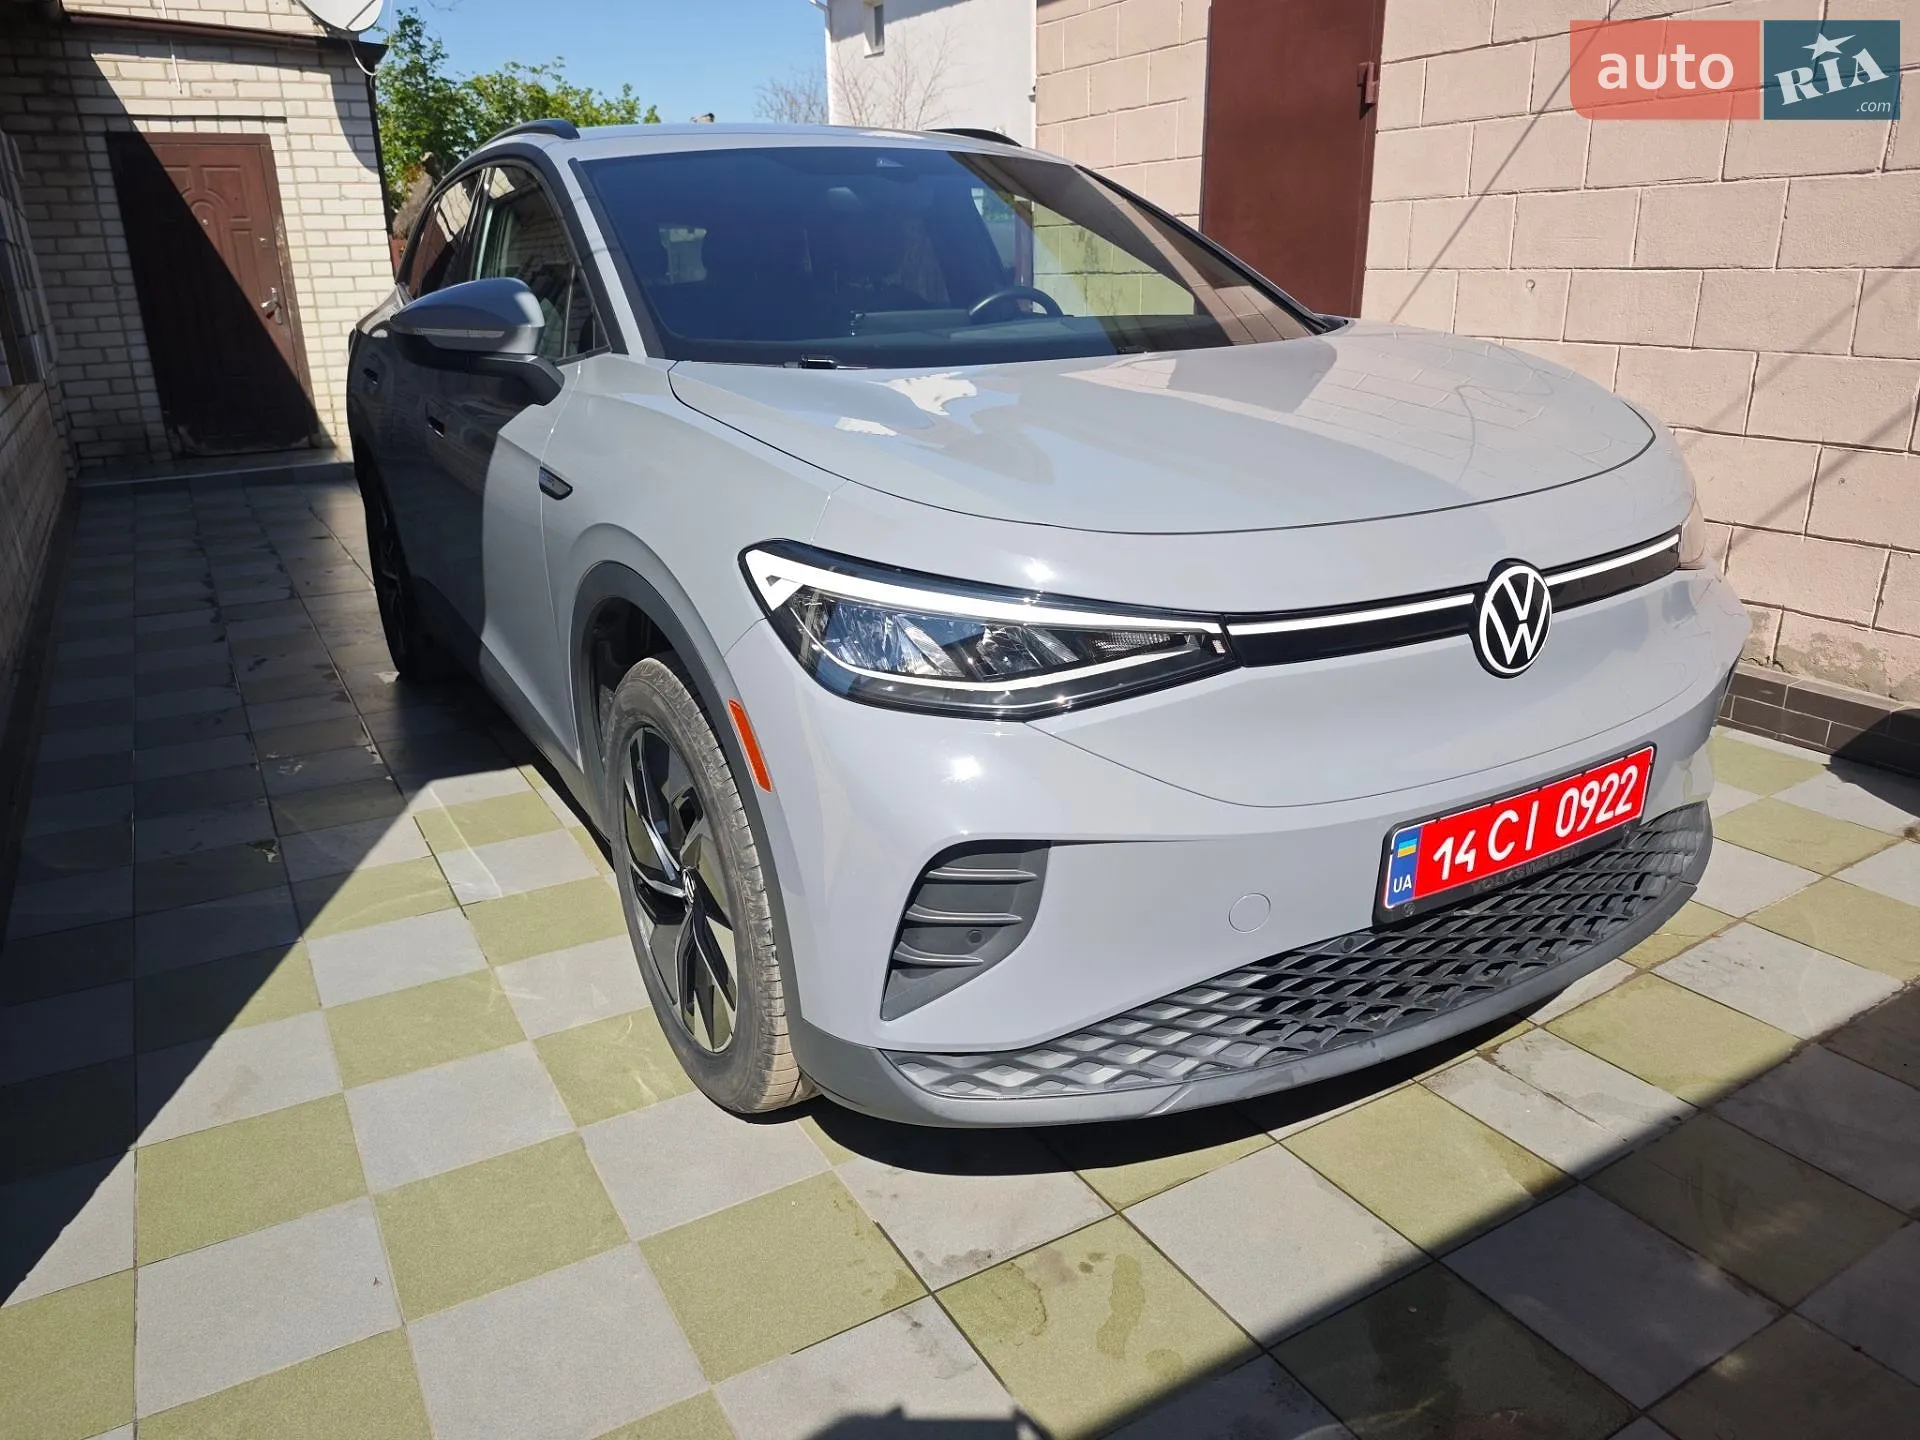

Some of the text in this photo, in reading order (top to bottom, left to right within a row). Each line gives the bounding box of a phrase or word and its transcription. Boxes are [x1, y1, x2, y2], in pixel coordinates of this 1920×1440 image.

[1433, 829, 1477, 880] 14
[1555, 765, 1639, 838] 0922
[1392, 875, 1413, 893] UA
